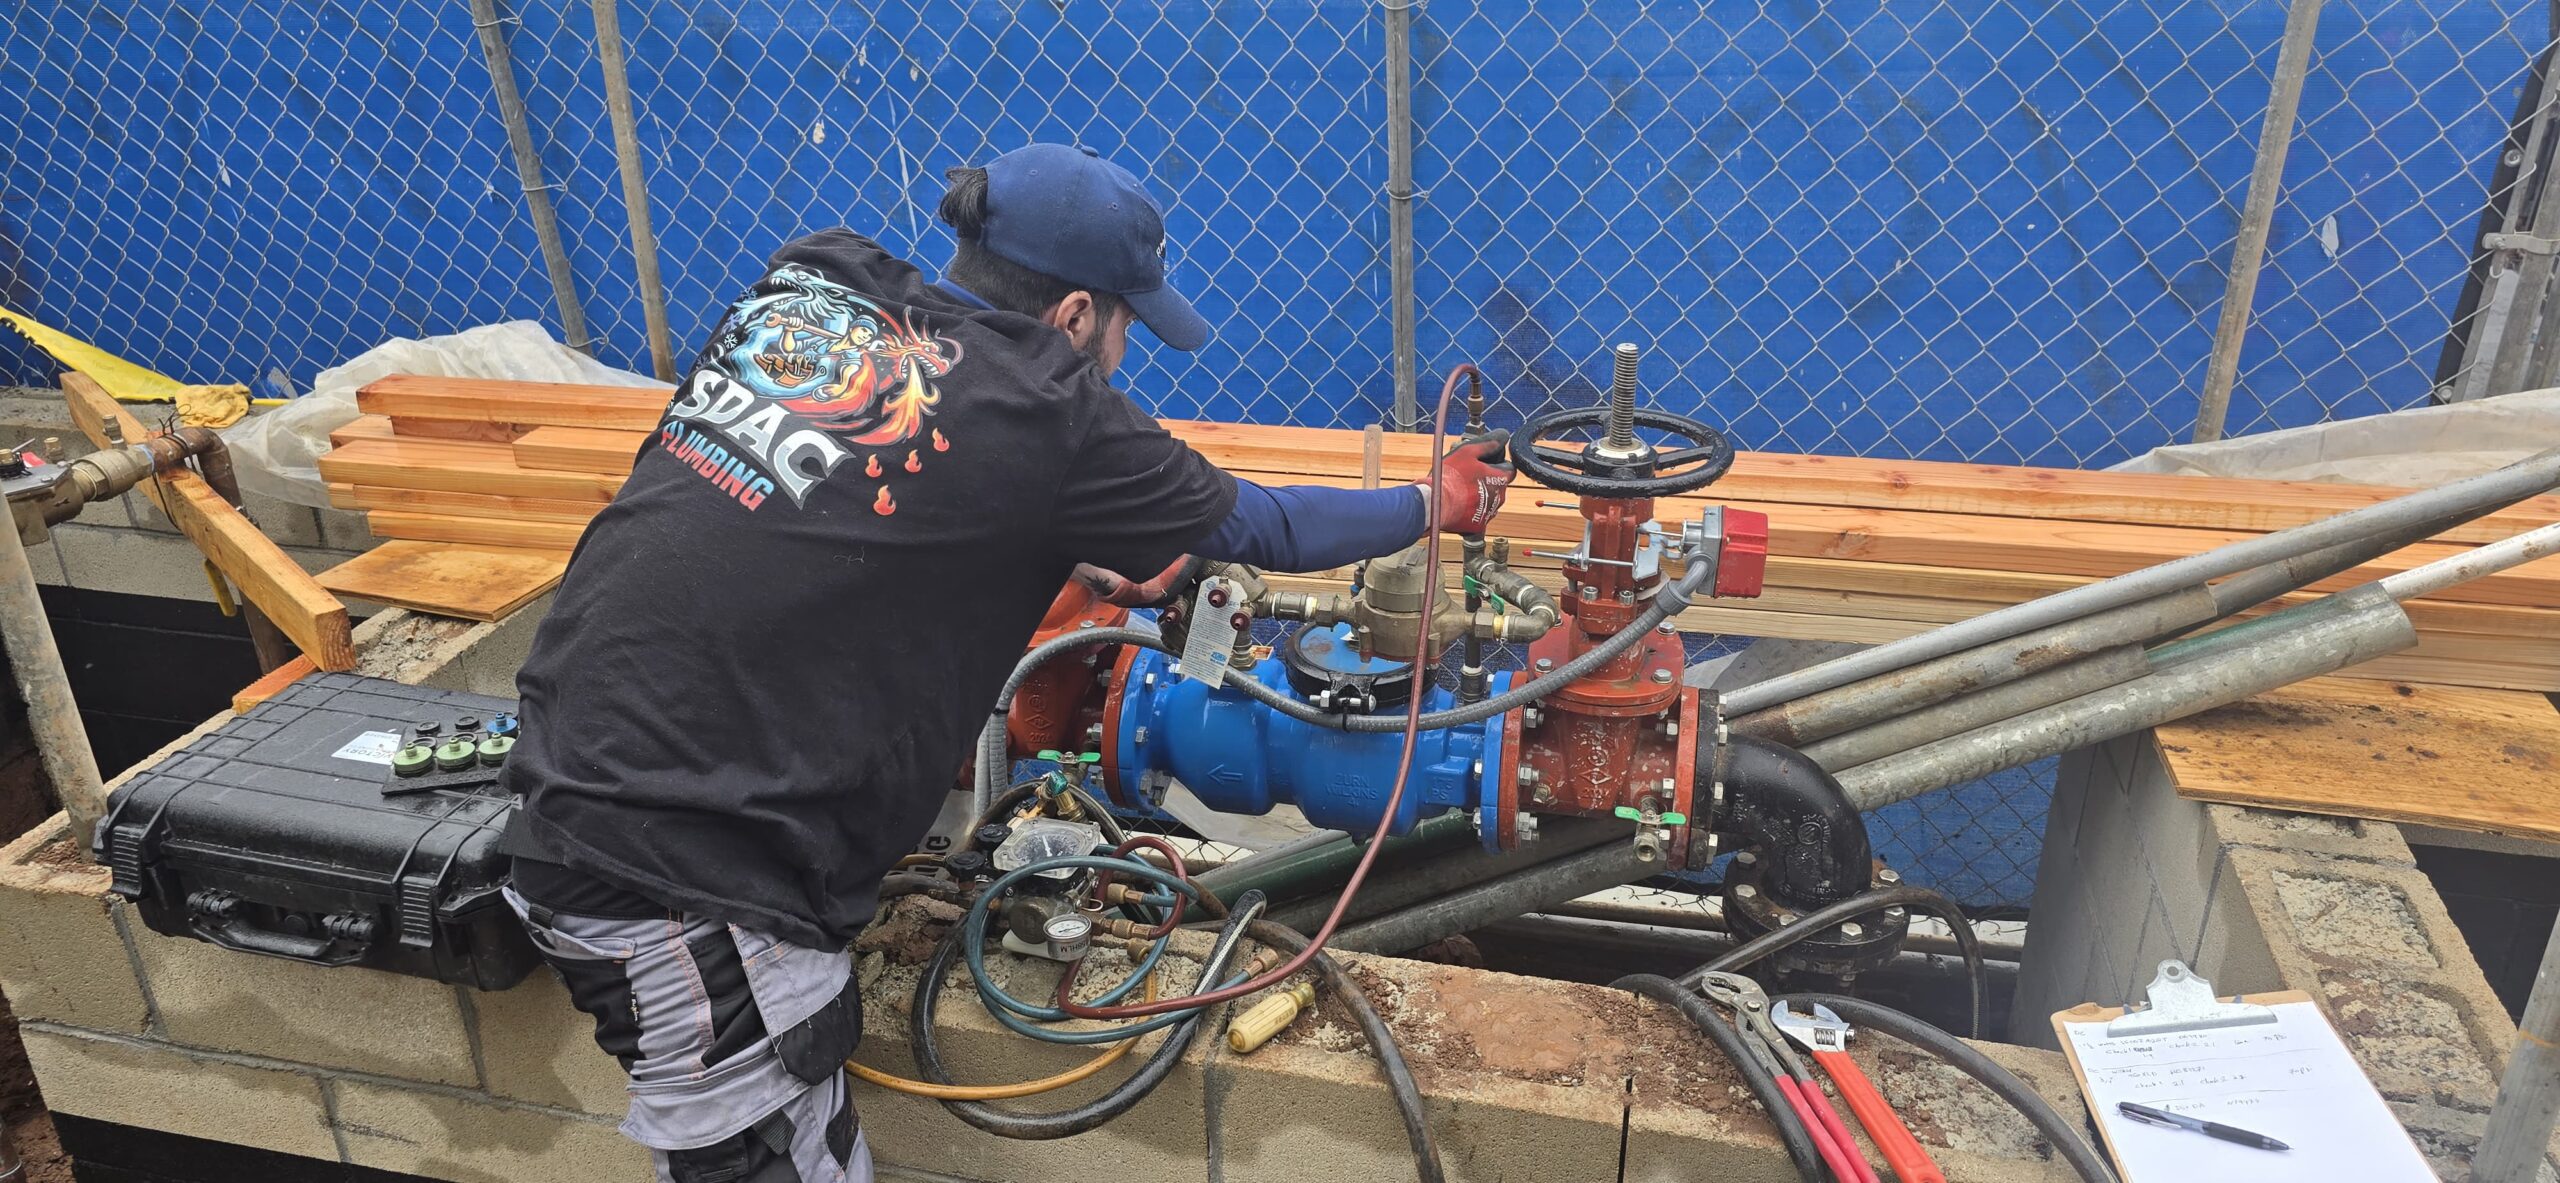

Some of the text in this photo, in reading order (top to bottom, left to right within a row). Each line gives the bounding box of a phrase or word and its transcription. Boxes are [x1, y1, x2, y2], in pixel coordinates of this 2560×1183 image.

[671, 369, 850, 502] SDAC
[660, 420, 775, 512] PLUMBING
[1472, 479, 1485, 523] Milwaukee
[343, 747, 394, 759] VICTORY
[1324, 783, 1379, 800] WILKINS
[1334, 772, 1370, 788] ZURN
